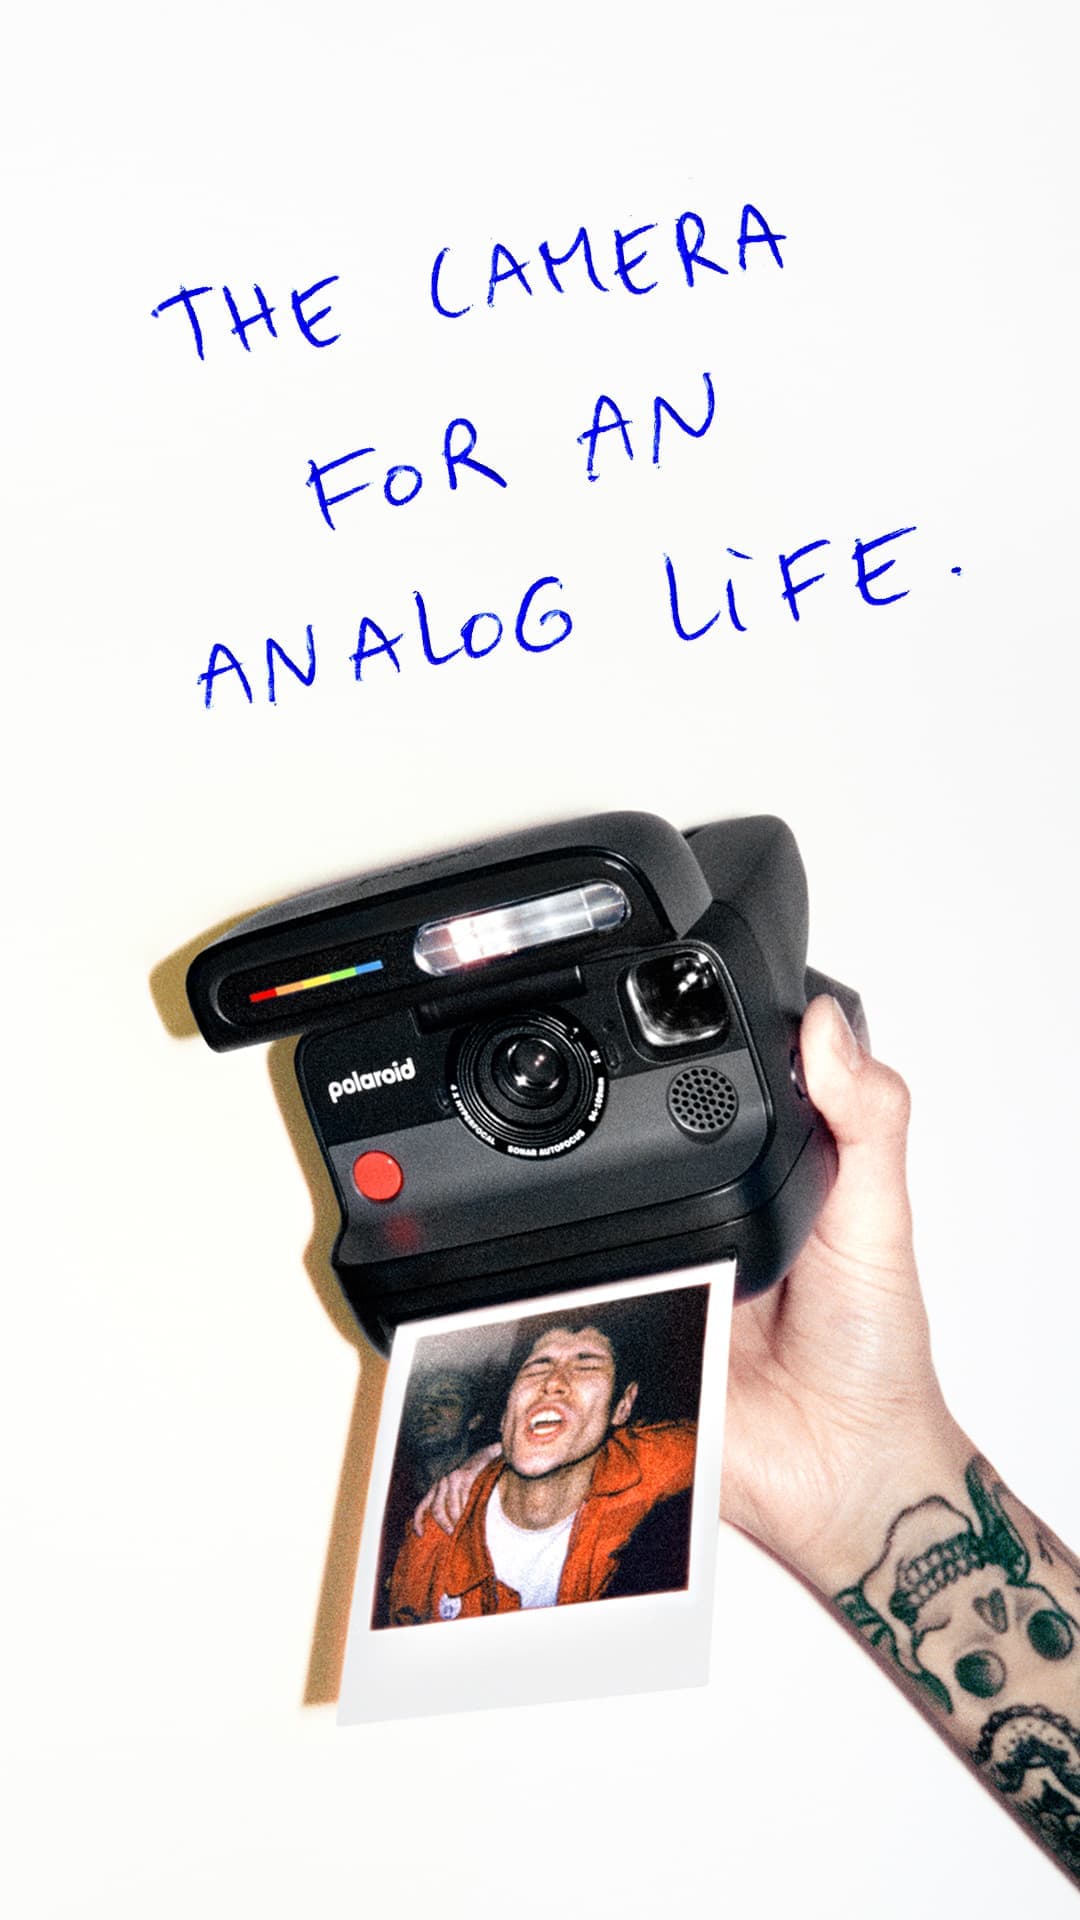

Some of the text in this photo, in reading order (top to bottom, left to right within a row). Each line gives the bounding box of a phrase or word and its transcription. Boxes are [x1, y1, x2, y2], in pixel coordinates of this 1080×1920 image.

[328, 1057, 416, 1104] polaroid
[455, 1100, 496, 1145] HYPERFOCAL
[507, 1129, 586, 1157] SONAR AUTOFOCUS
